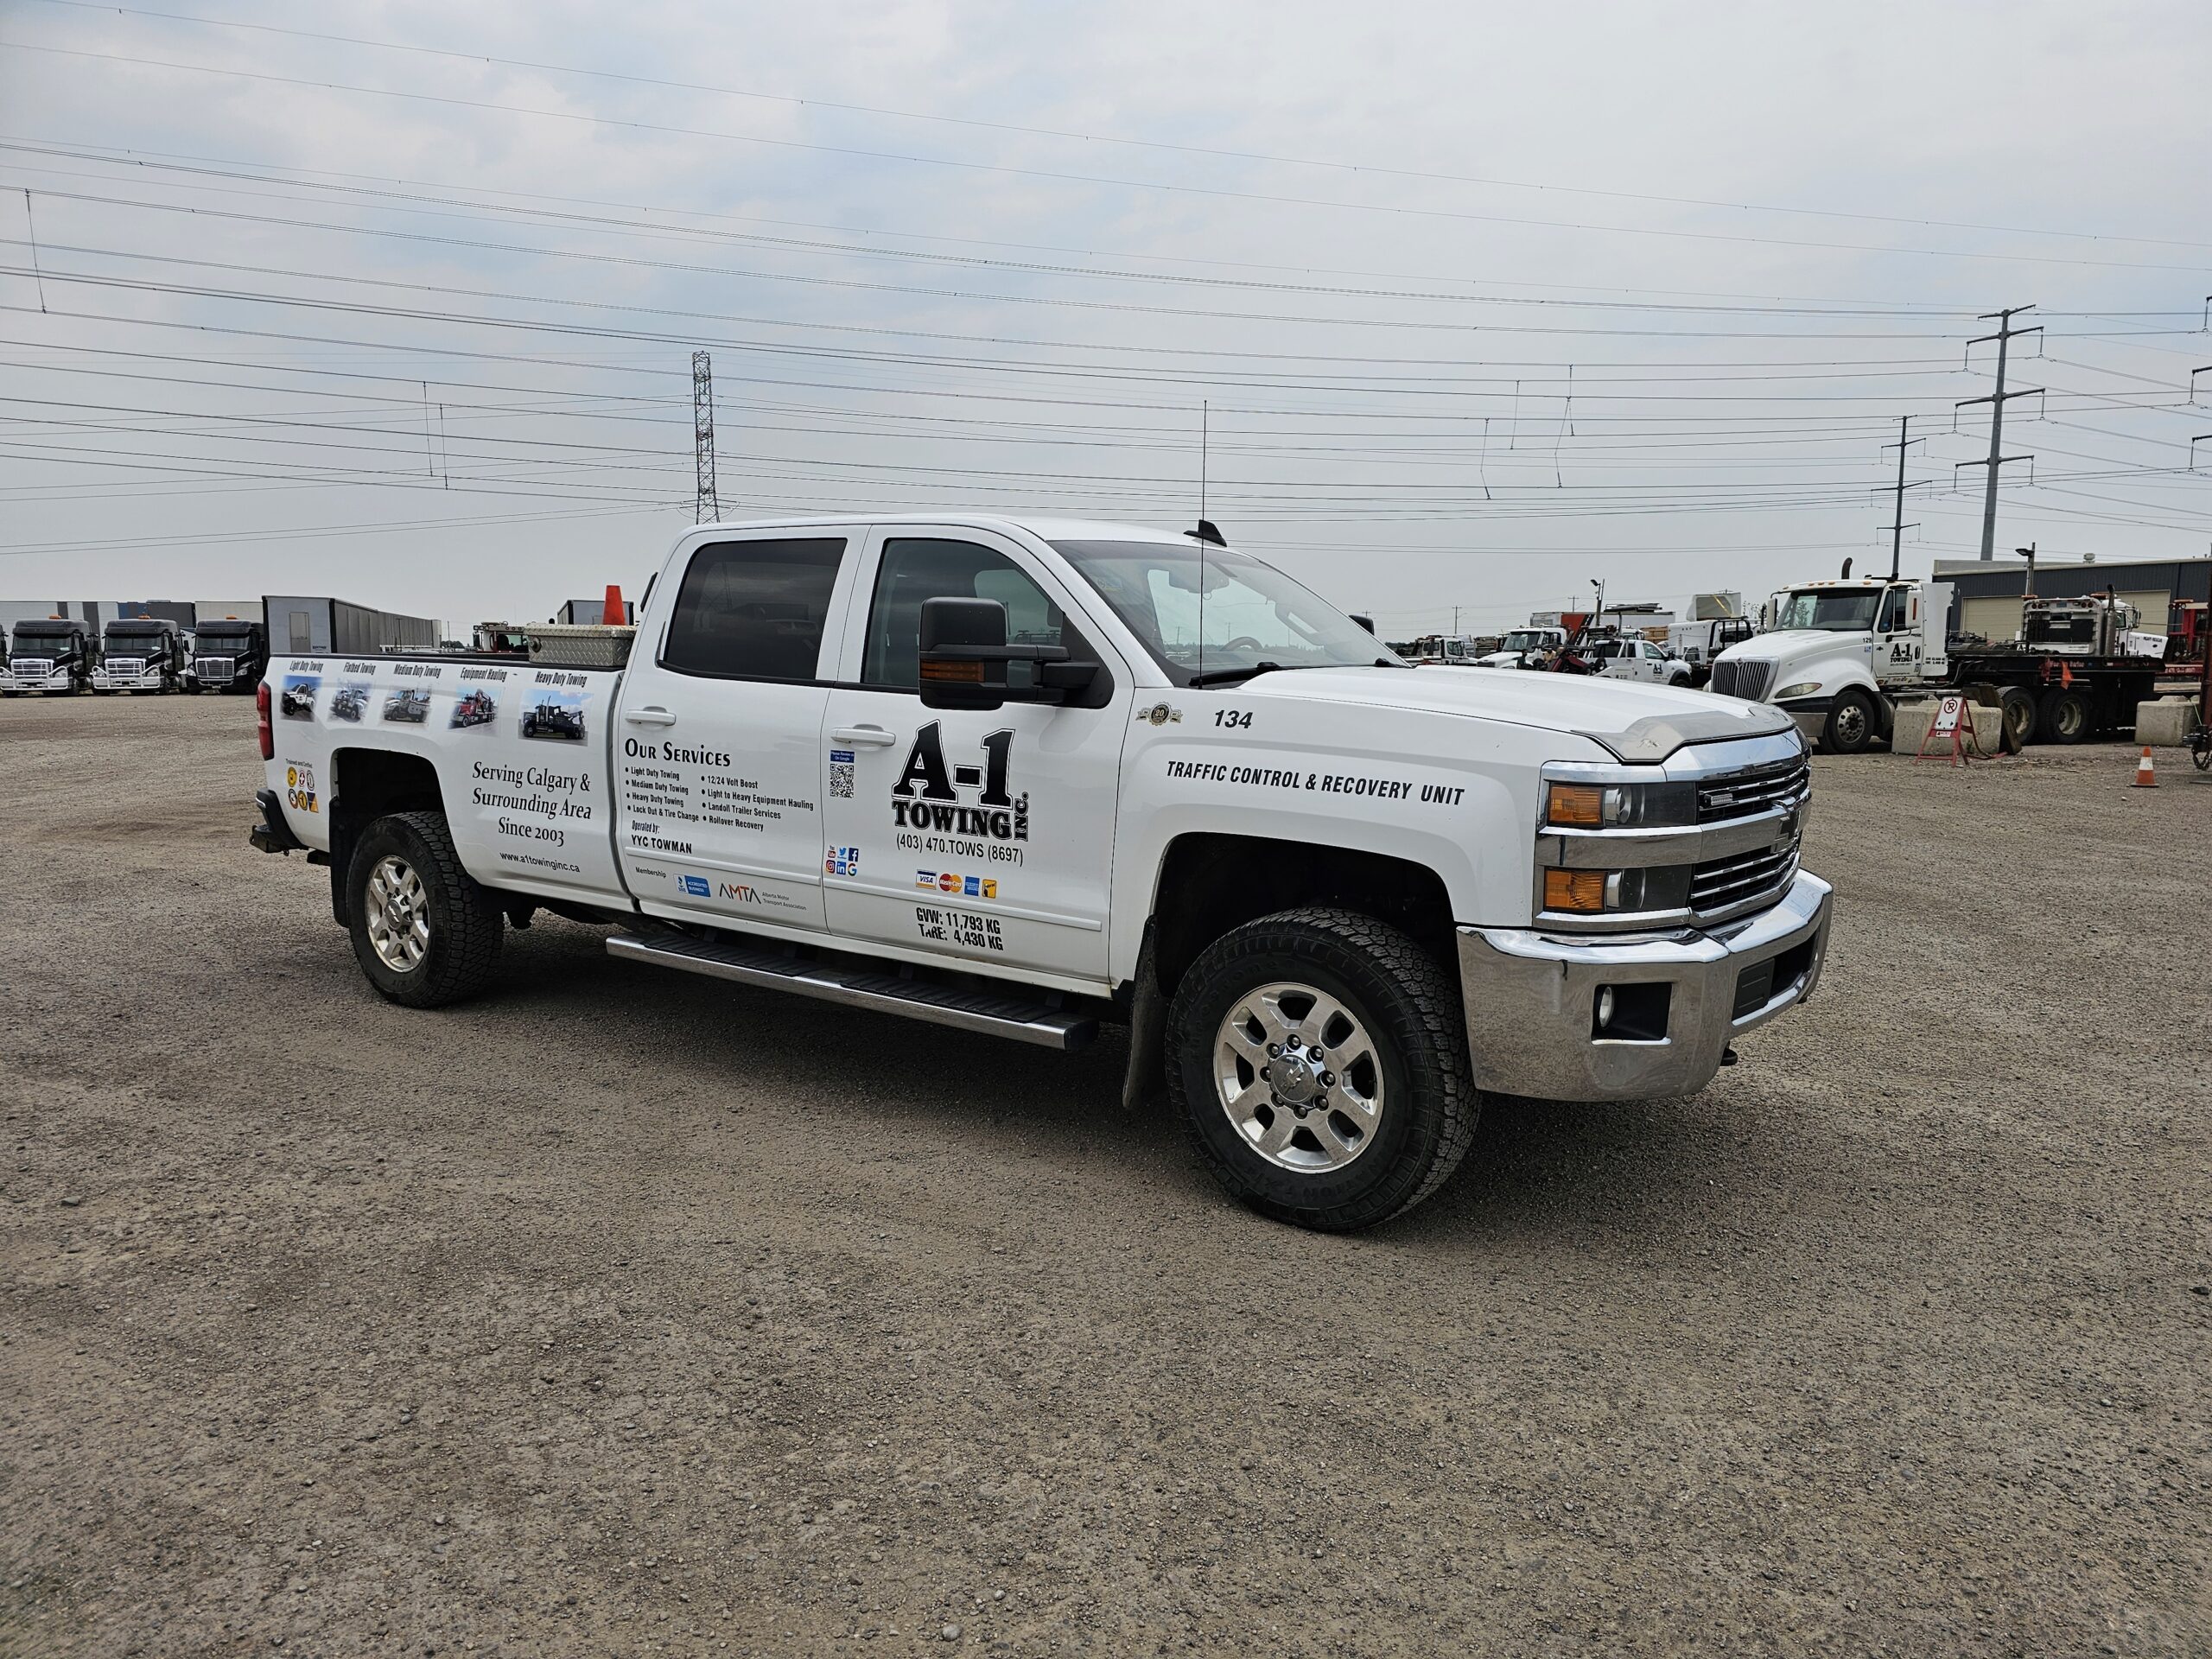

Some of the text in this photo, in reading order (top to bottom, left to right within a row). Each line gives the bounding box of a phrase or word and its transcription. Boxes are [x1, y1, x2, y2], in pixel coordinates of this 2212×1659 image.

[1891, 643, 1910, 657] A-1
[289, 660, 324, 673] Light Duty Towing
[343, 662, 377, 676] Flatbed Towing
[394, 664, 442, 679] Medium Duty Towing
[461, 667, 508, 683] Equipment Hauling
[535, 671, 588, 688] Heavy Duty Towing
[1214, 709, 1254, 729] 134
[891, 719, 1015, 810] A-1
[472, 761, 591, 795] Serving Calgary &
[631, 766, 680, 781] Light Duty Towing
[707, 775, 759, 789] 12/24 Volt Boost
[632, 779, 689, 795] Medium Duty Towing
[1167, 760, 1465, 806] TRAFFIC CONTROL & RECOVERY UNIT
[472, 787, 592, 820] Surrounding Area
[632, 792, 684, 808] Heavy Duty Towing
[707, 788, 814, 811] Light to Heavy Equipment Hauling
[632, 804, 700, 822] Lock Out & Tire Change
[709, 802, 782, 819] Landoll Trailer Services
[1014, 791, 1029, 842] INC.
[632, 820, 652, 833] Operated
[709, 815, 764, 832] Rollover Recovery
[891, 799, 1013, 841] TOWING
[498, 817, 564, 848] Since 2003
[631, 834, 692, 854] YYC TOWMAN
[896, 833, 1023, 867] (403) 470.TOWS (8697)
[499, 851, 581, 873] www.a1towinginc.ca
[635, 867, 667, 879] Membership
[919, 875, 934, 884] VISA
[939, 879, 962, 887] MasterCard
[719, 882, 762, 905] AMTA
[916, 906, 1001, 935] GVW: 11,793 KG
[953, 929, 986, 948] 4,430
[987, 935, 1004, 951] KG
